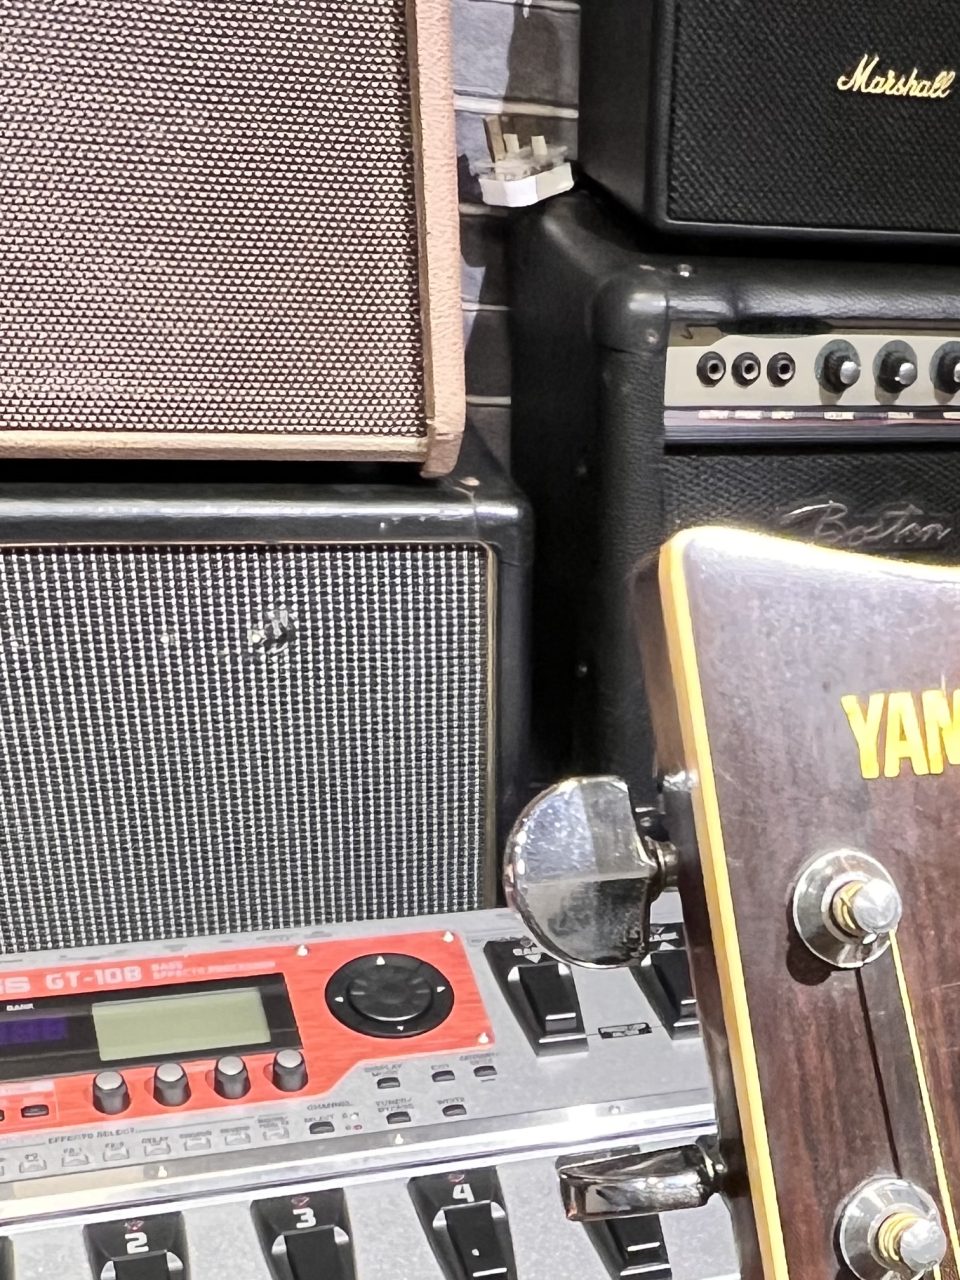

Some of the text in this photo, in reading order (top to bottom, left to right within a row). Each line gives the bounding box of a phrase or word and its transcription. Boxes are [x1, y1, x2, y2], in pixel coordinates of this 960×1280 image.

[837, 53, 955, 98] Marshall
[452, 1183, 475, 1203] 4
[292, 1207, 317, 1228] 3
[124, 1232, 149, 1254] 2
